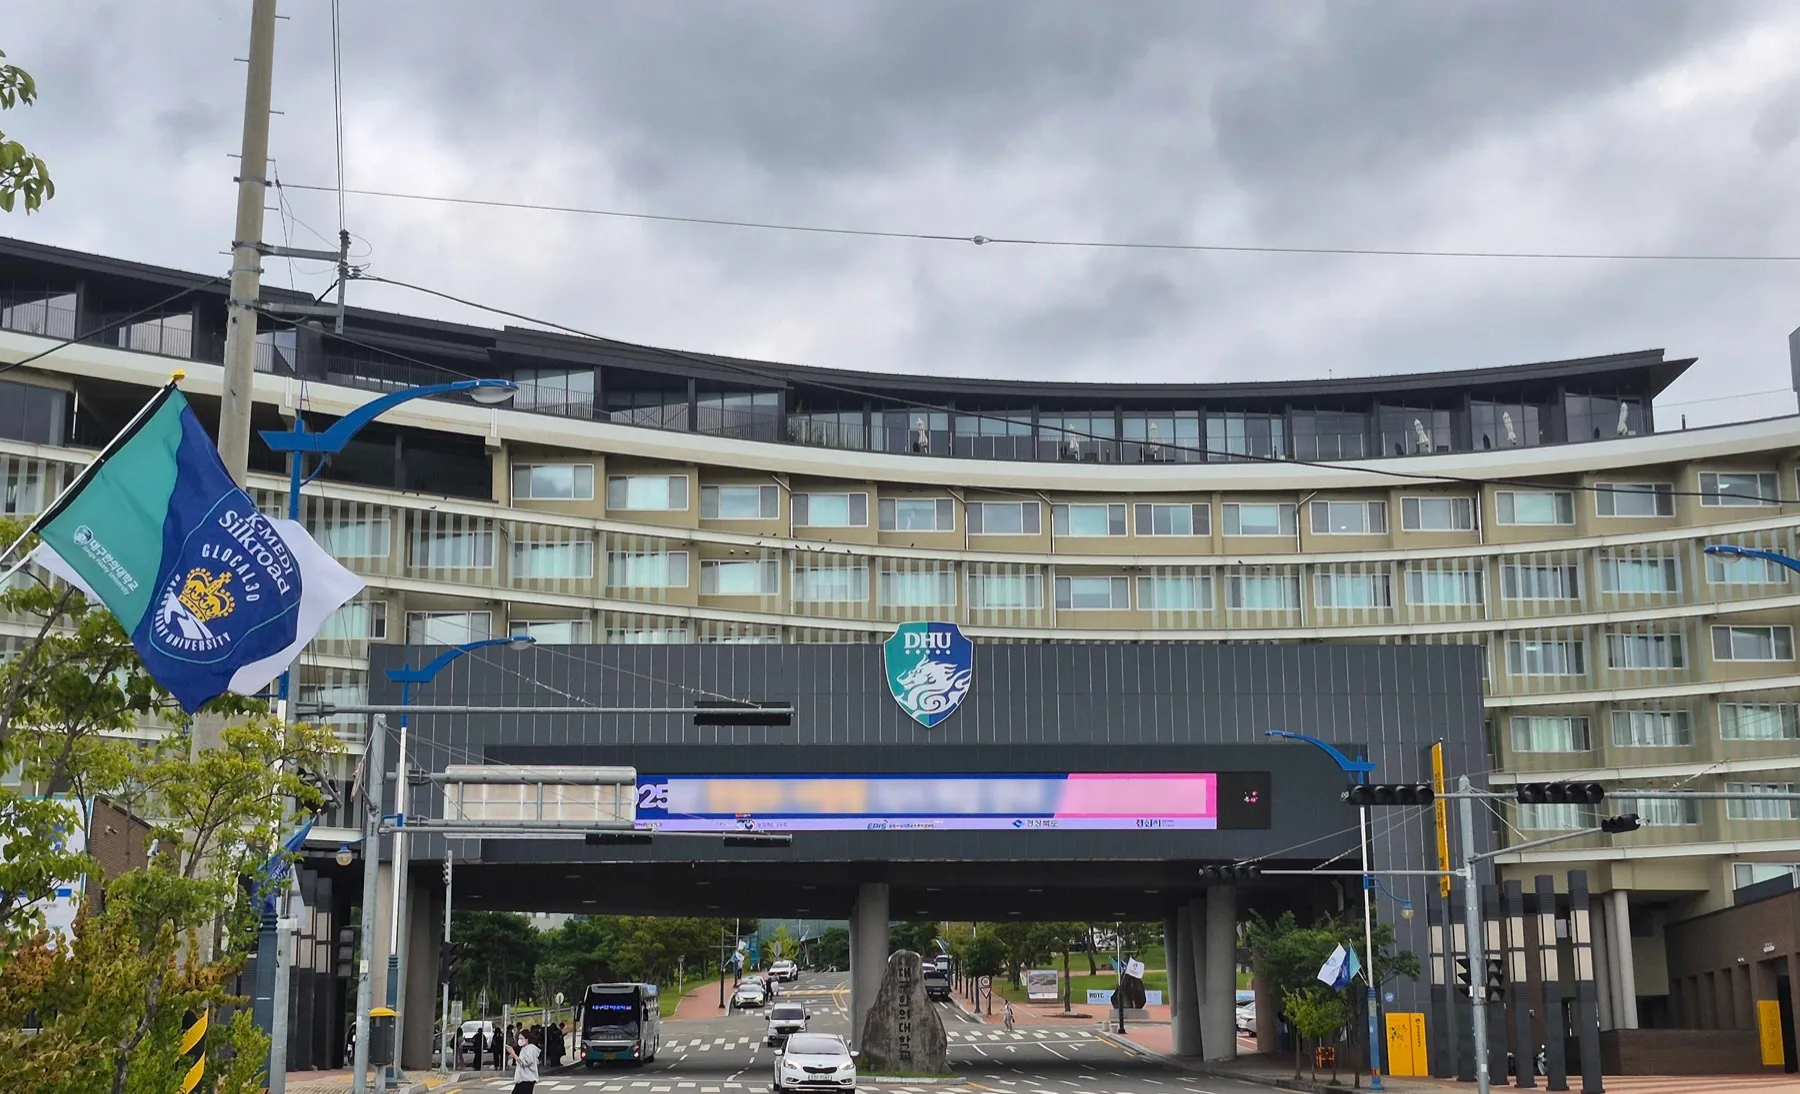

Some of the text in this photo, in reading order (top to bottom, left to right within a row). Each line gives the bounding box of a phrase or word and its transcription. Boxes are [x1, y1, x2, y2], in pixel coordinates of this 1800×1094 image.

[218, 510, 290, 596] Silkroad
[246, 512, 293, 575] K-MEDI
[89, 540, 139, 591] 대구한의대학교
[165, 632, 231, 651] UNIVERSITY
[904, 632, 952, 649] DHU
[1026, 819, 1059, 827] 경상북도
